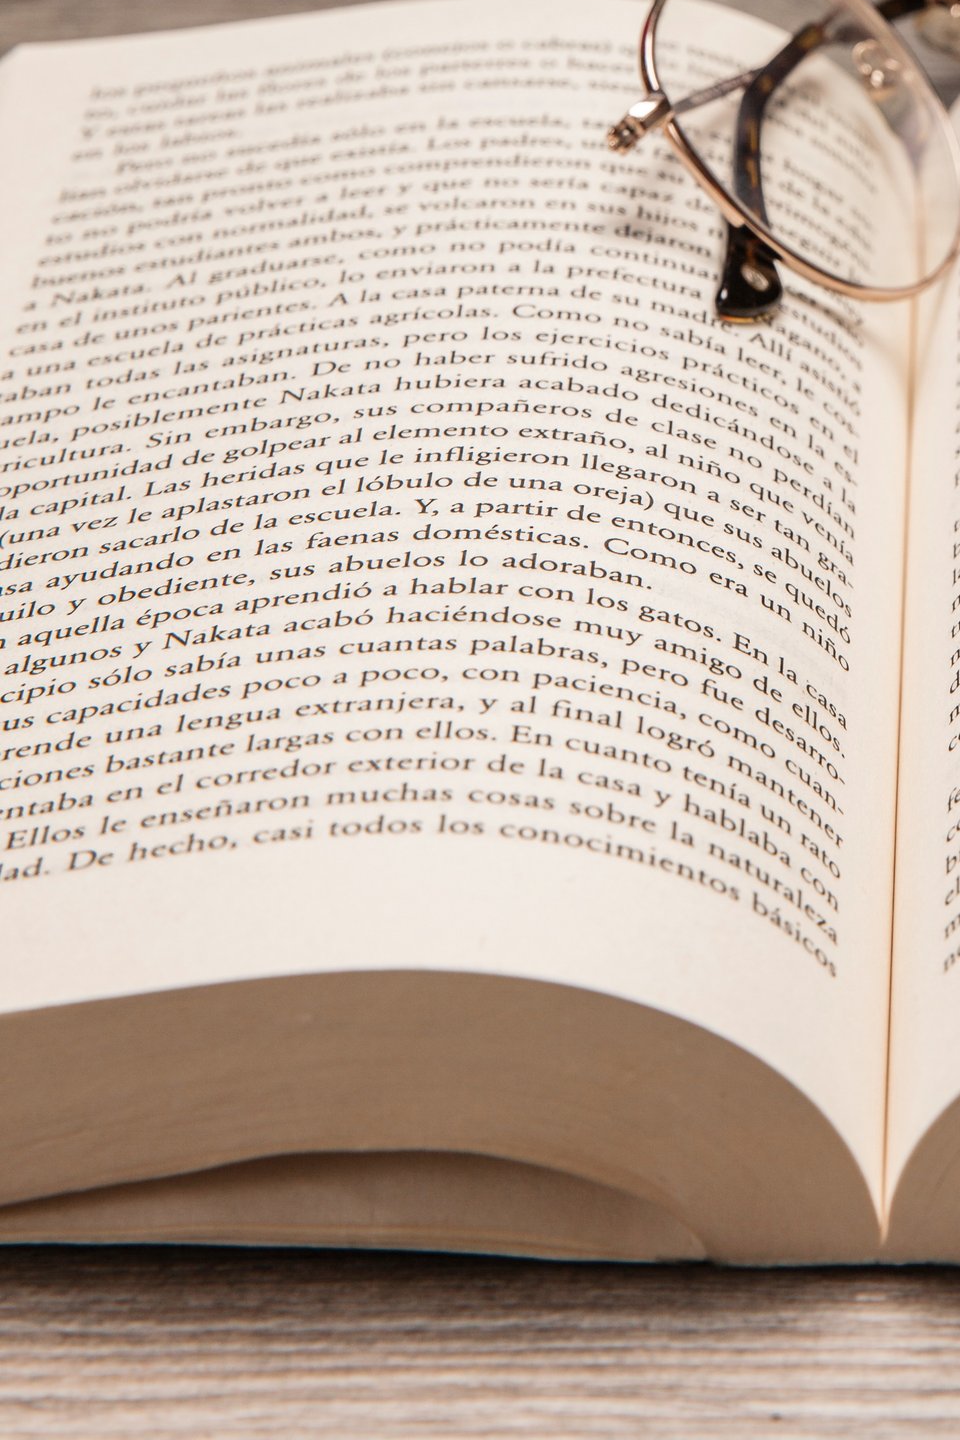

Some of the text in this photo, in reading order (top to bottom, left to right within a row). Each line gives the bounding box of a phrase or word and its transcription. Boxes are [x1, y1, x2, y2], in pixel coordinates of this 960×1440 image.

[15, 320, 48, 335] en
[58, 310, 83, 328] el
[92, 290, 207, 324] instituto
[338, 269, 365, 284] lo
[375, 263, 496, 280] enviaron
[507, 263, 521, 273] a
[533, 258, 555, 274] la
[566, 265, 701, 298] prefectura
[92, 395, 116, 412] le
[127, 371, 296, 405] encantaban.
[311, 360, 351, 377] De
[364, 358, 401, 371] no
[414, 349, 495, 366] haber
[506, 351, 608, 372] sufrido
[619, 365, 758, 417] agresiones
[768, 416, 797, 439] en
[70, 515, 119, 533] vez
[126, 506, 153, 525] le
[160, 487, 310, 522] aplastaron
[320, 477, 346, 497] el
[354, 471, 454, 493] lóbulo
[462, 470, 499, 488] de
[508, 477, 563, 492] una
[572, 483, 655, 511] oreja)
[662, 501, 715, 528] que
[722, 522, 763, 549] sus
[770, 546, 852, 619] abuelos
[181, 423, 854, 567] de golpear al elemento extraño, al niño que venía
[44, 522, 850, 672] ayudando en las faenas domésticas. Como era un niño
[3, 645, 123, 676] algunos
[131, 640, 153, 660] y
[161, 623, 270, 650] Nakata
[282, 607, 374, 633] acabó
[385, 604, 562, 629] haciéndose
[573, 619, 643, 647] muy
[653, 638, 743, 680] amigo
[752, 675, 783, 704] de
[45, 682, 231, 725] capacidades
[241, 674, 322, 700] poco
[331, 671, 348, 685] a
[359, 667, 449, 688] poco,
[461, 667, 519, 683] con
[531, 672, 687, 720] paciencia,
[697, 712, 776, 759] como
[5, 781, 837, 945] Ellos le enseñaron muchas cosas sobre la naturaleza
[943, 875, 960, 907] el
